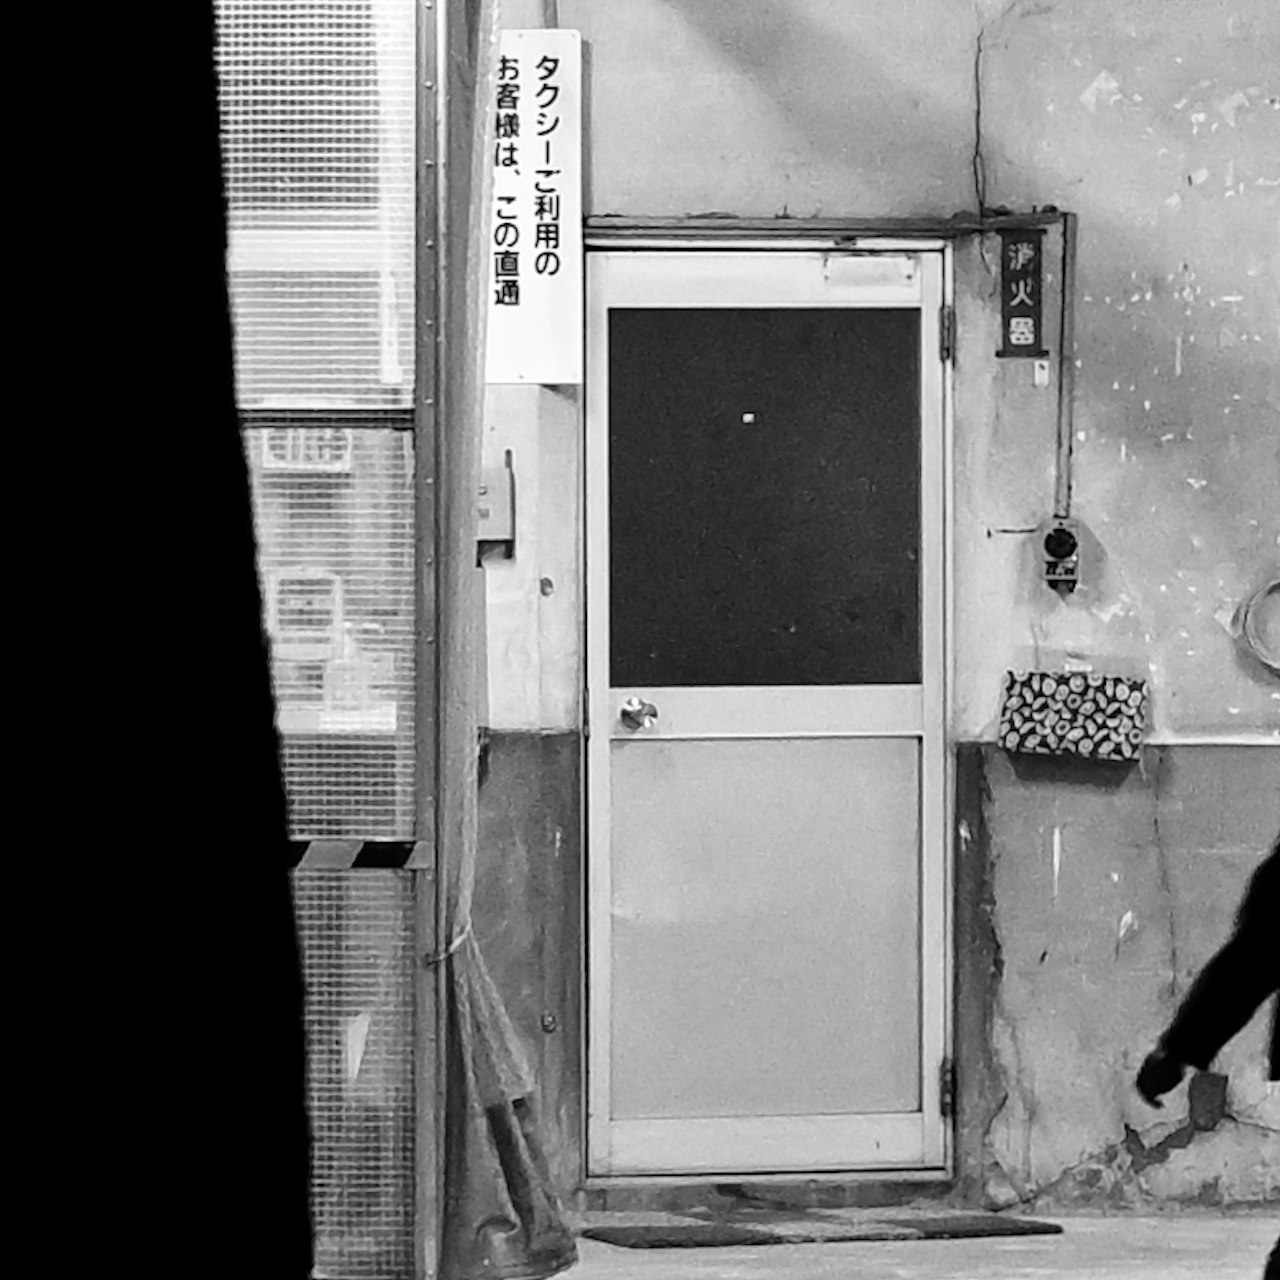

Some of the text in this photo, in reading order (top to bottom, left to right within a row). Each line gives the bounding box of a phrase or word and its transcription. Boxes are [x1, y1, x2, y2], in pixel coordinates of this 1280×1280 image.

[493, 56, 520, 306] お客様は、この直通
[535, 55, 560, 276] タクシーご利用の
